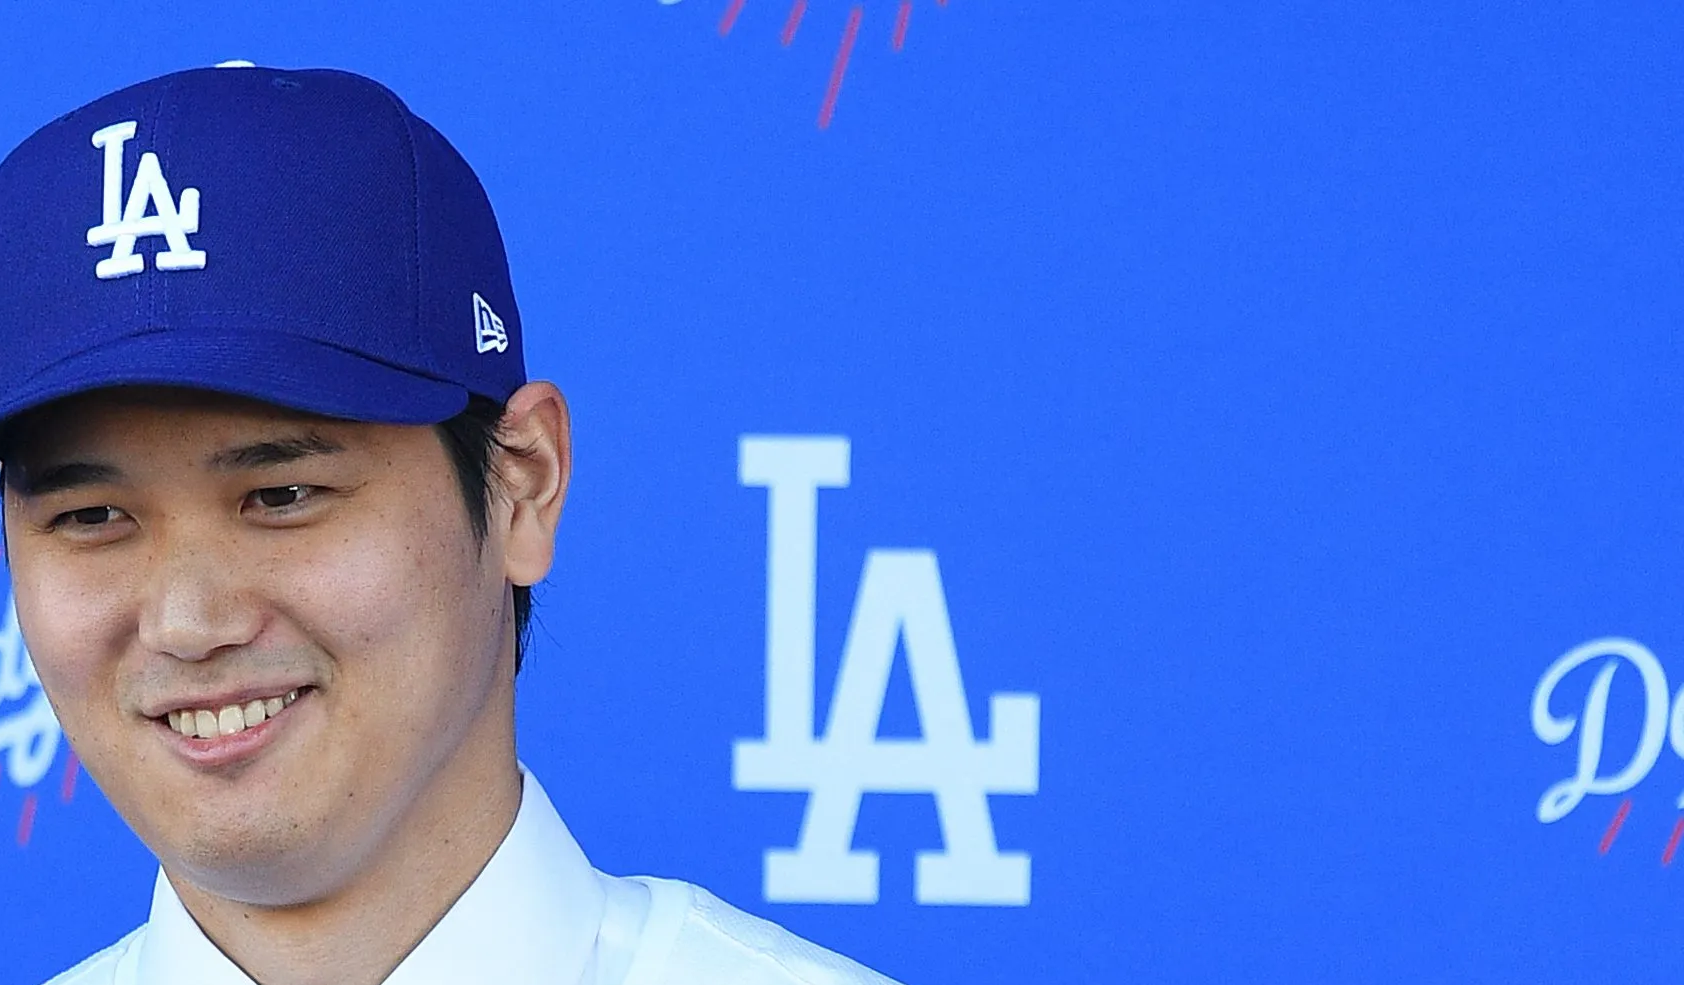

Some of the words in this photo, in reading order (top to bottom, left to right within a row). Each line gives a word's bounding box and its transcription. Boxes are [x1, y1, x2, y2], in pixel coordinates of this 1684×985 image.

[87, 120, 206, 279] LA
[732, 434, 1041, 906] LA
[1530, 636, 1684, 824] D
